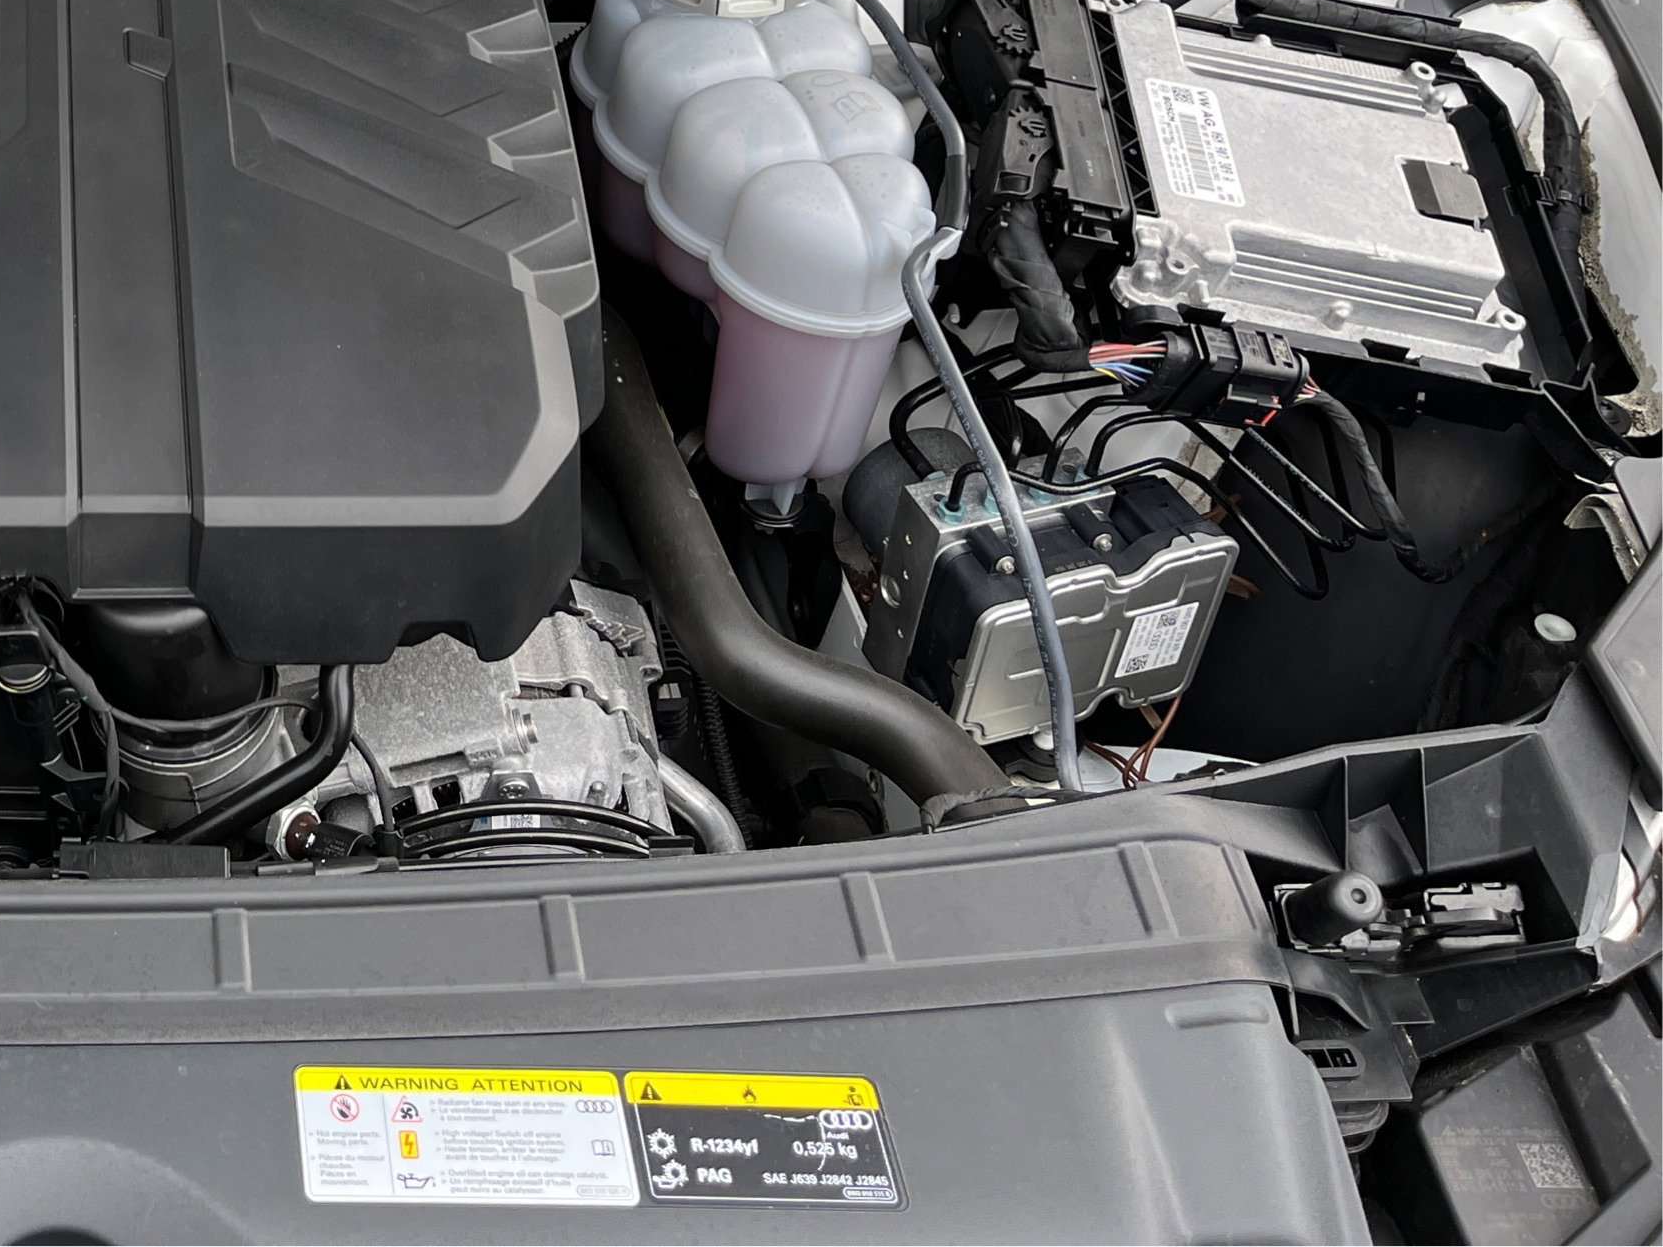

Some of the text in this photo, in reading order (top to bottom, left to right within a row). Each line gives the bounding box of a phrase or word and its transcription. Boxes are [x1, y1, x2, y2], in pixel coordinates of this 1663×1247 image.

[1197, 91, 1211, 109] VW
[1163, 95, 1176, 123] BOSCH
[1202, 110, 1216, 127] AG
[358, 1076, 584, 1093] WARNING ATTENTION
[827, 1131, 849, 1140] Audi
[690, 1137, 759, 1157] R-1234yf
[838, 1141, 858, 1160] kg
[697, 1168, 732, 1184] PAG
[762, 1172, 889, 1187] SAE J639 J2842 J2845
